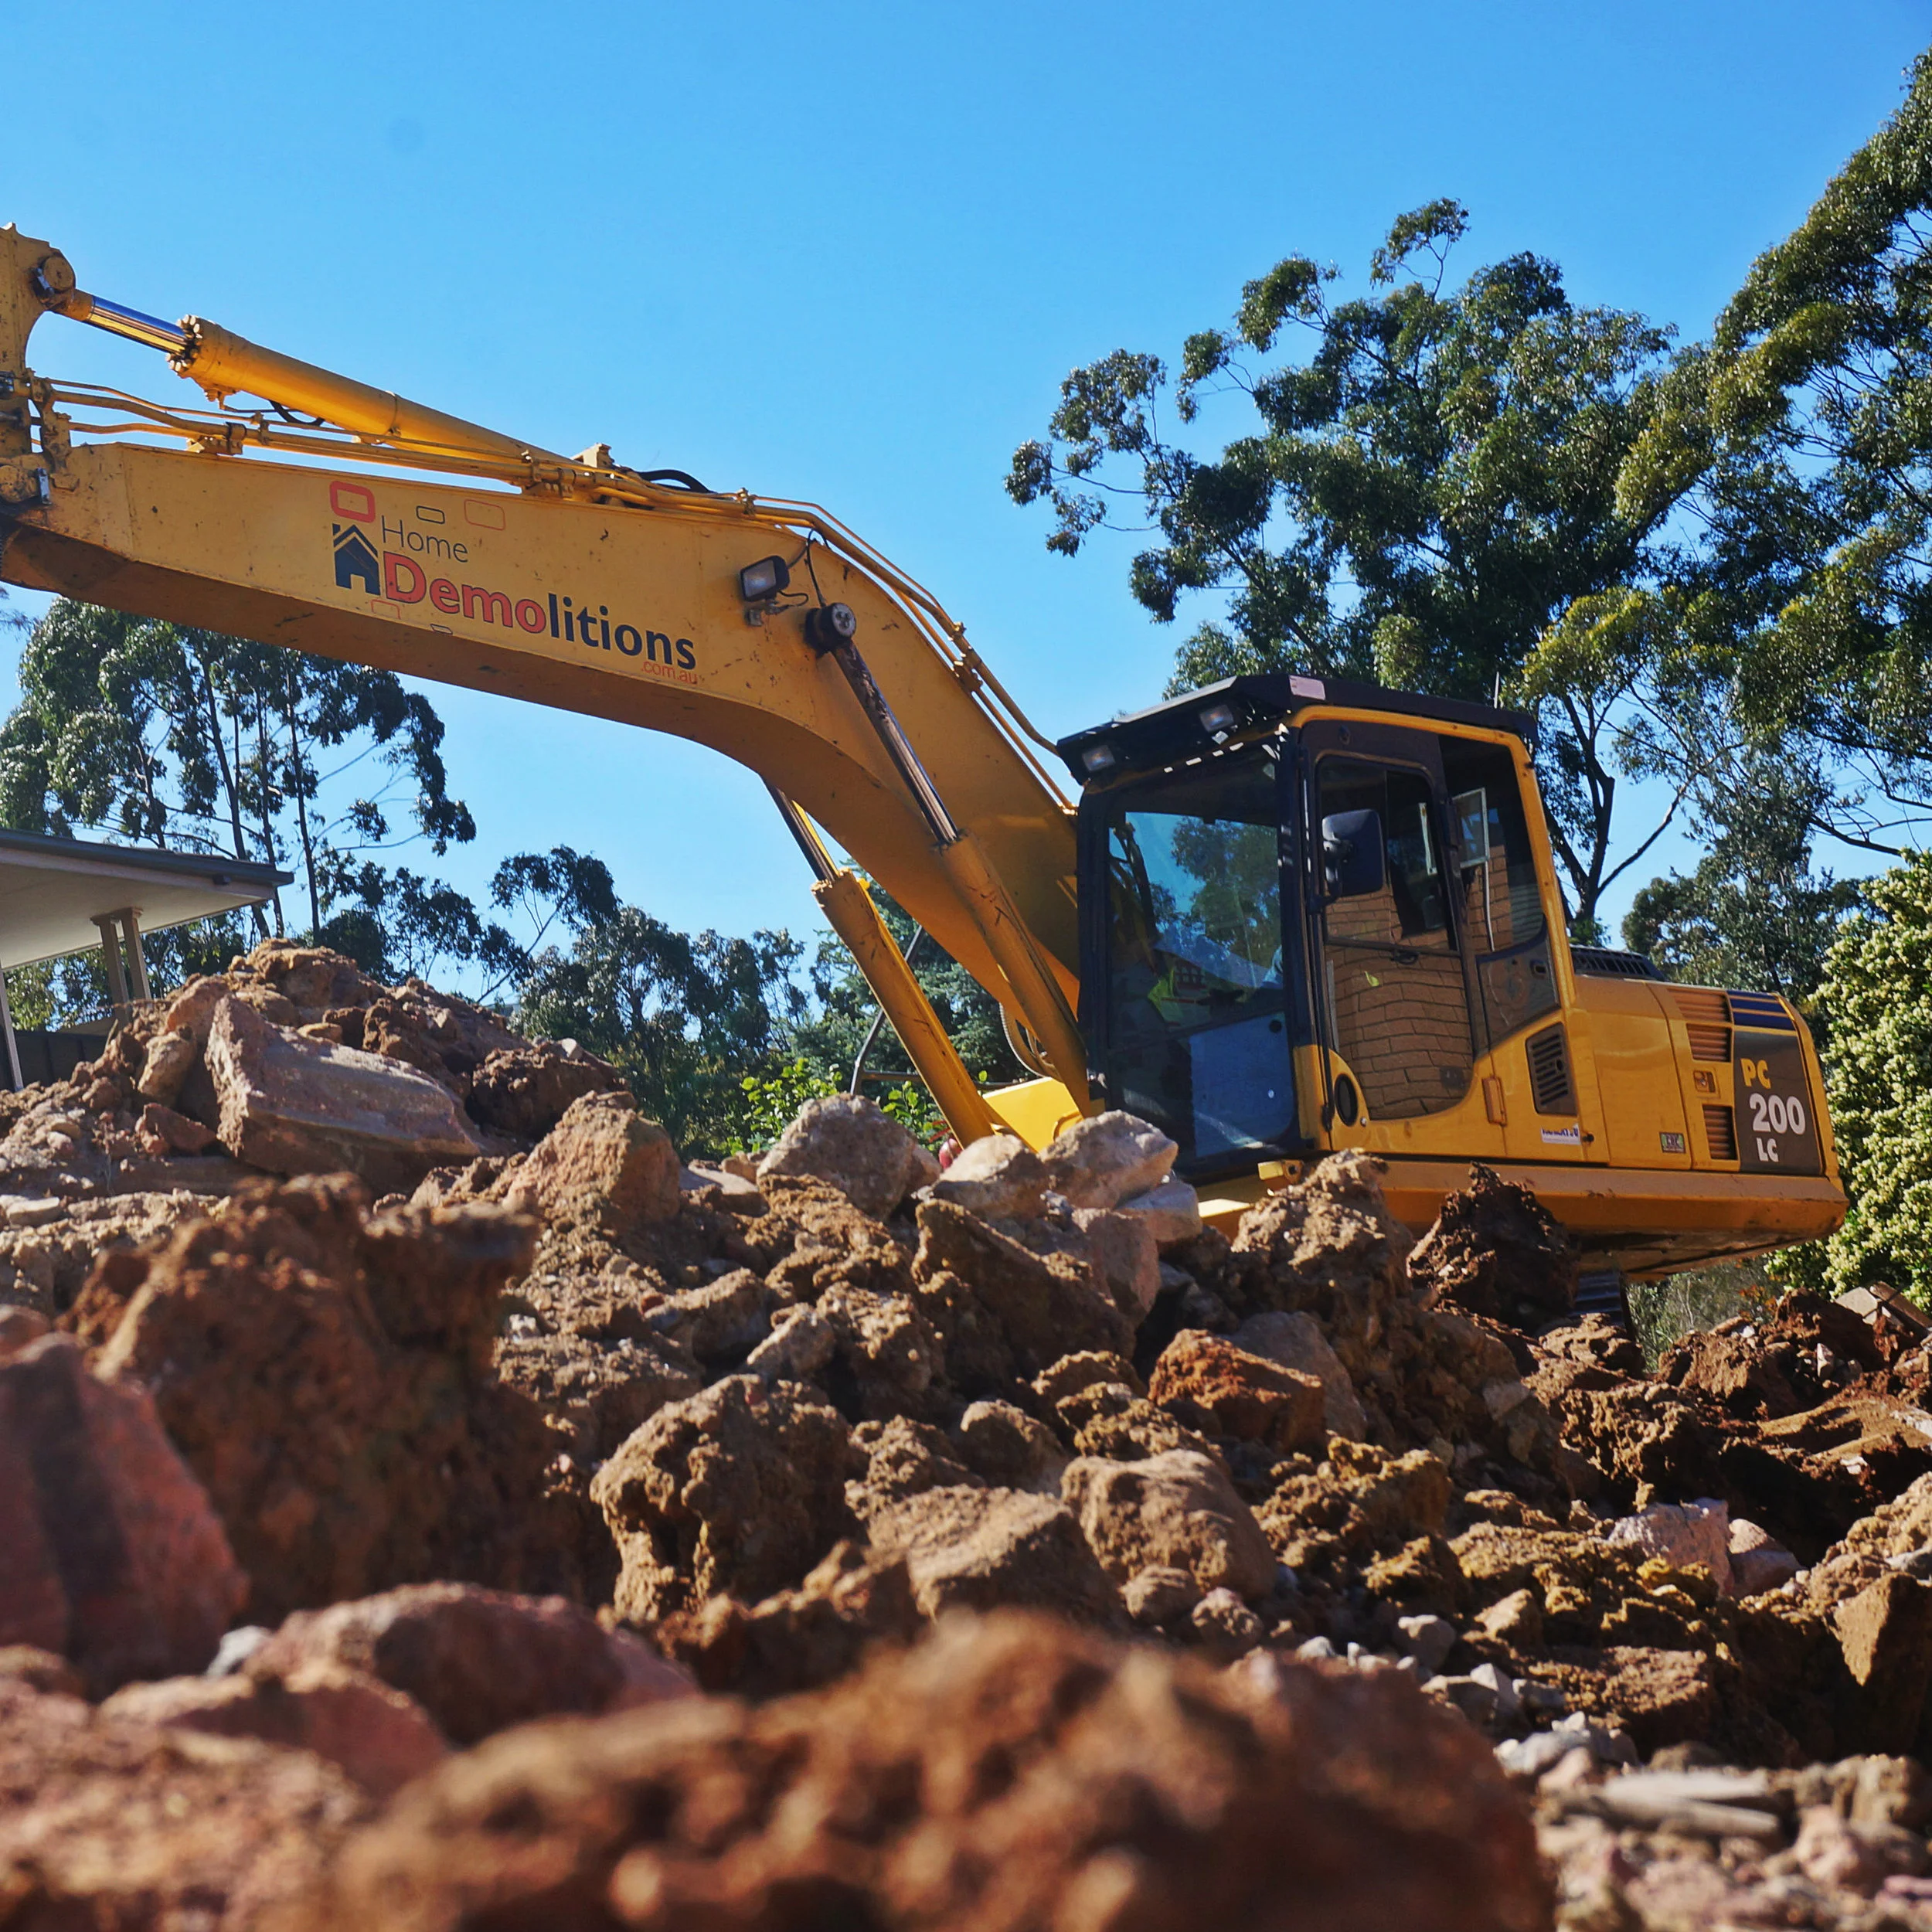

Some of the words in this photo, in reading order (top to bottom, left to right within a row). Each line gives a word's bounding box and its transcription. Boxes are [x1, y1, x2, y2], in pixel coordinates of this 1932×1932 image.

[381, 515, 468, 563] Home
[383, 550, 697, 670] Demolitions
[1740, 1058, 1771, 1090] PC
[1750, 1093, 1806, 1135] 200
[1757, 1138, 1779, 1162] LC
